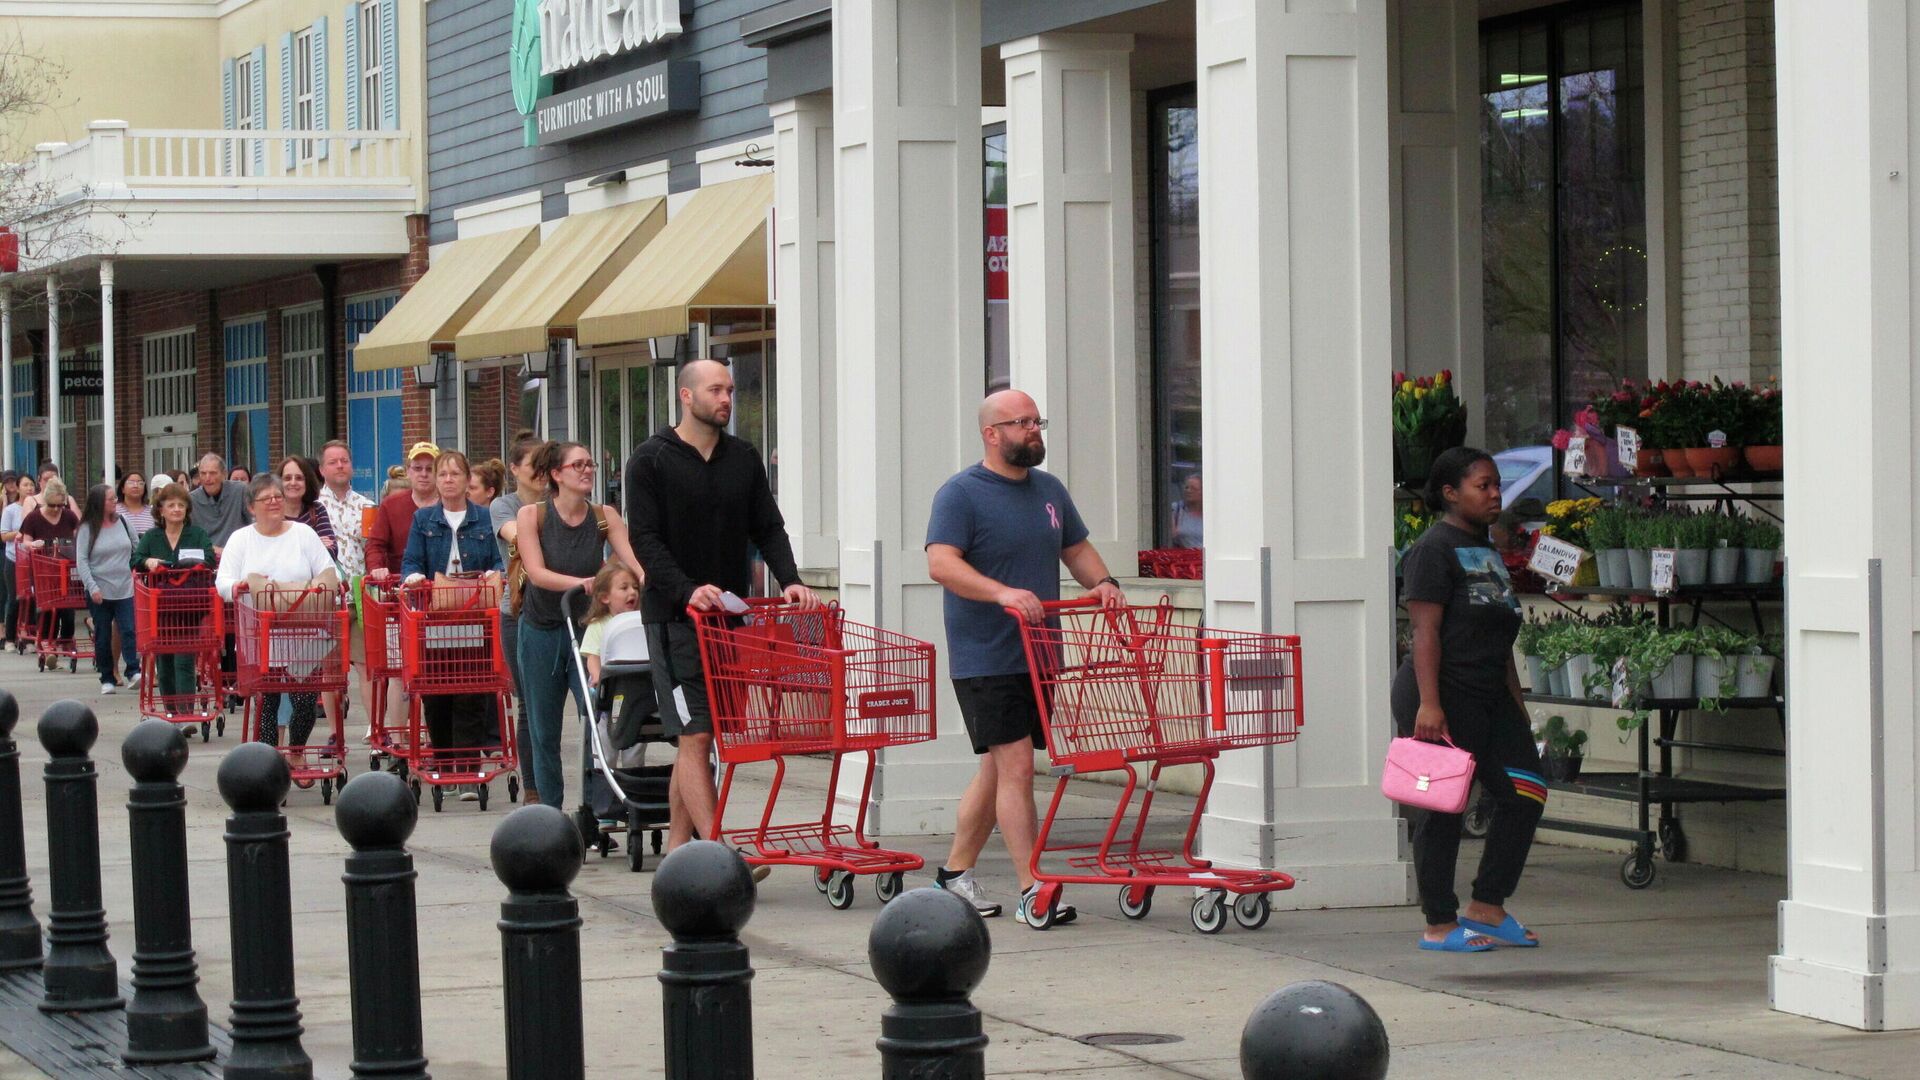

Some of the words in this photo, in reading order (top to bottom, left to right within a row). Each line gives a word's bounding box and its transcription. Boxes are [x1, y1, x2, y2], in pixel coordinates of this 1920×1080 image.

[538, 96, 592, 134] FURNITURE
[597, 87, 622, 118] WITH
[626, 84, 632, 110] A
[636, 74, 666, 106] SOUL
[64, 376, 104, 390] petco
[866, 700, 890, 708] TRADER
